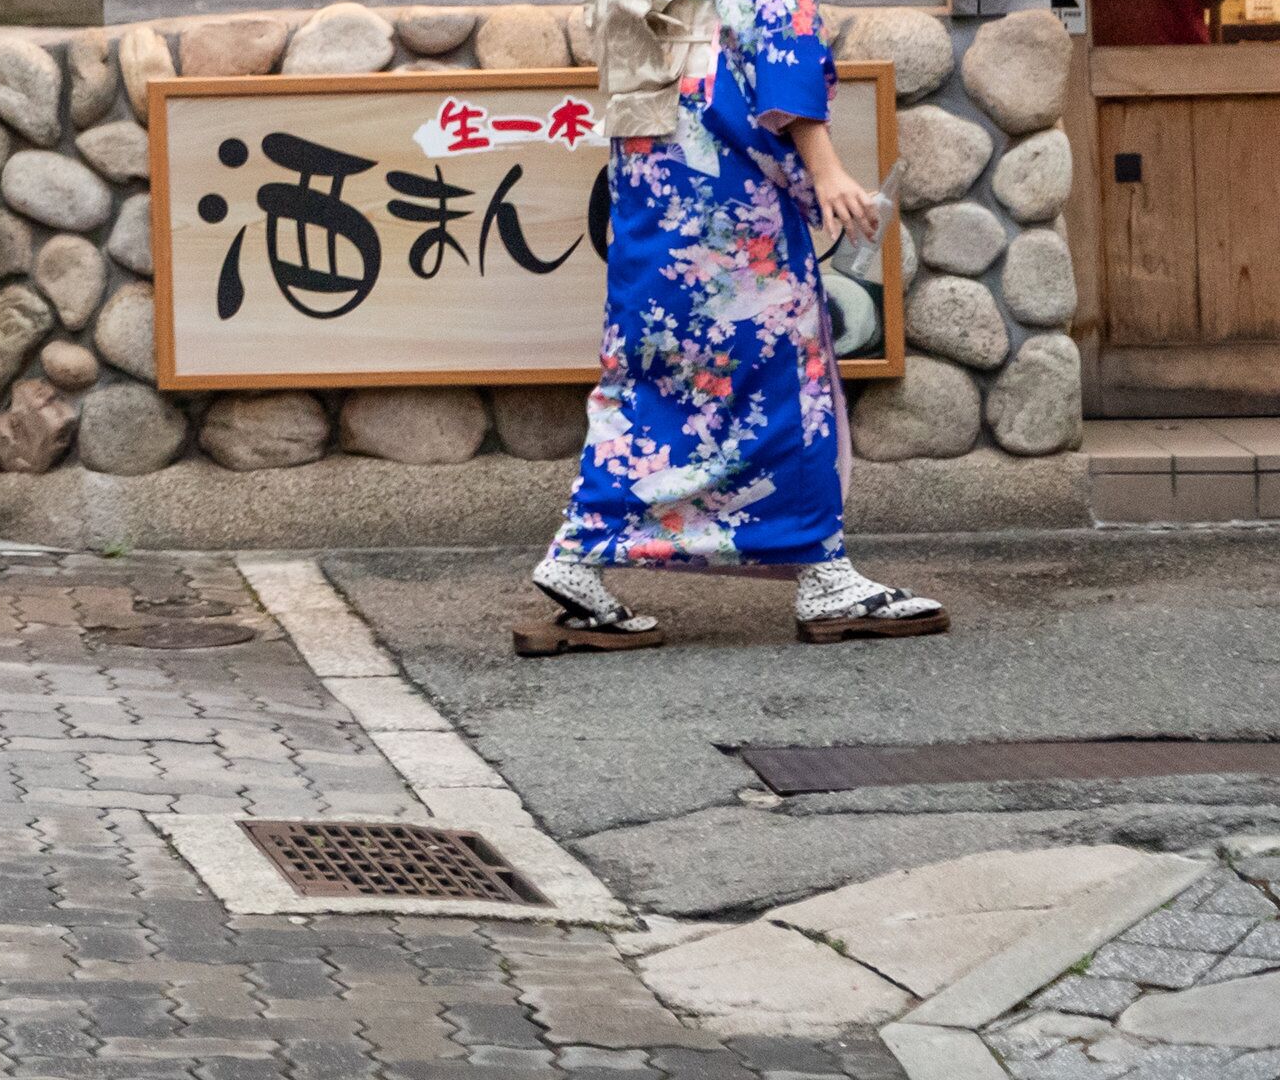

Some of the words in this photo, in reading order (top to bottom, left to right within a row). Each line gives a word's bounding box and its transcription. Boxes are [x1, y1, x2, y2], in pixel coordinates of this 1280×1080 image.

[438, 95, 595, 153] 生一本
[197, 131, 611, 321] 酒まん
